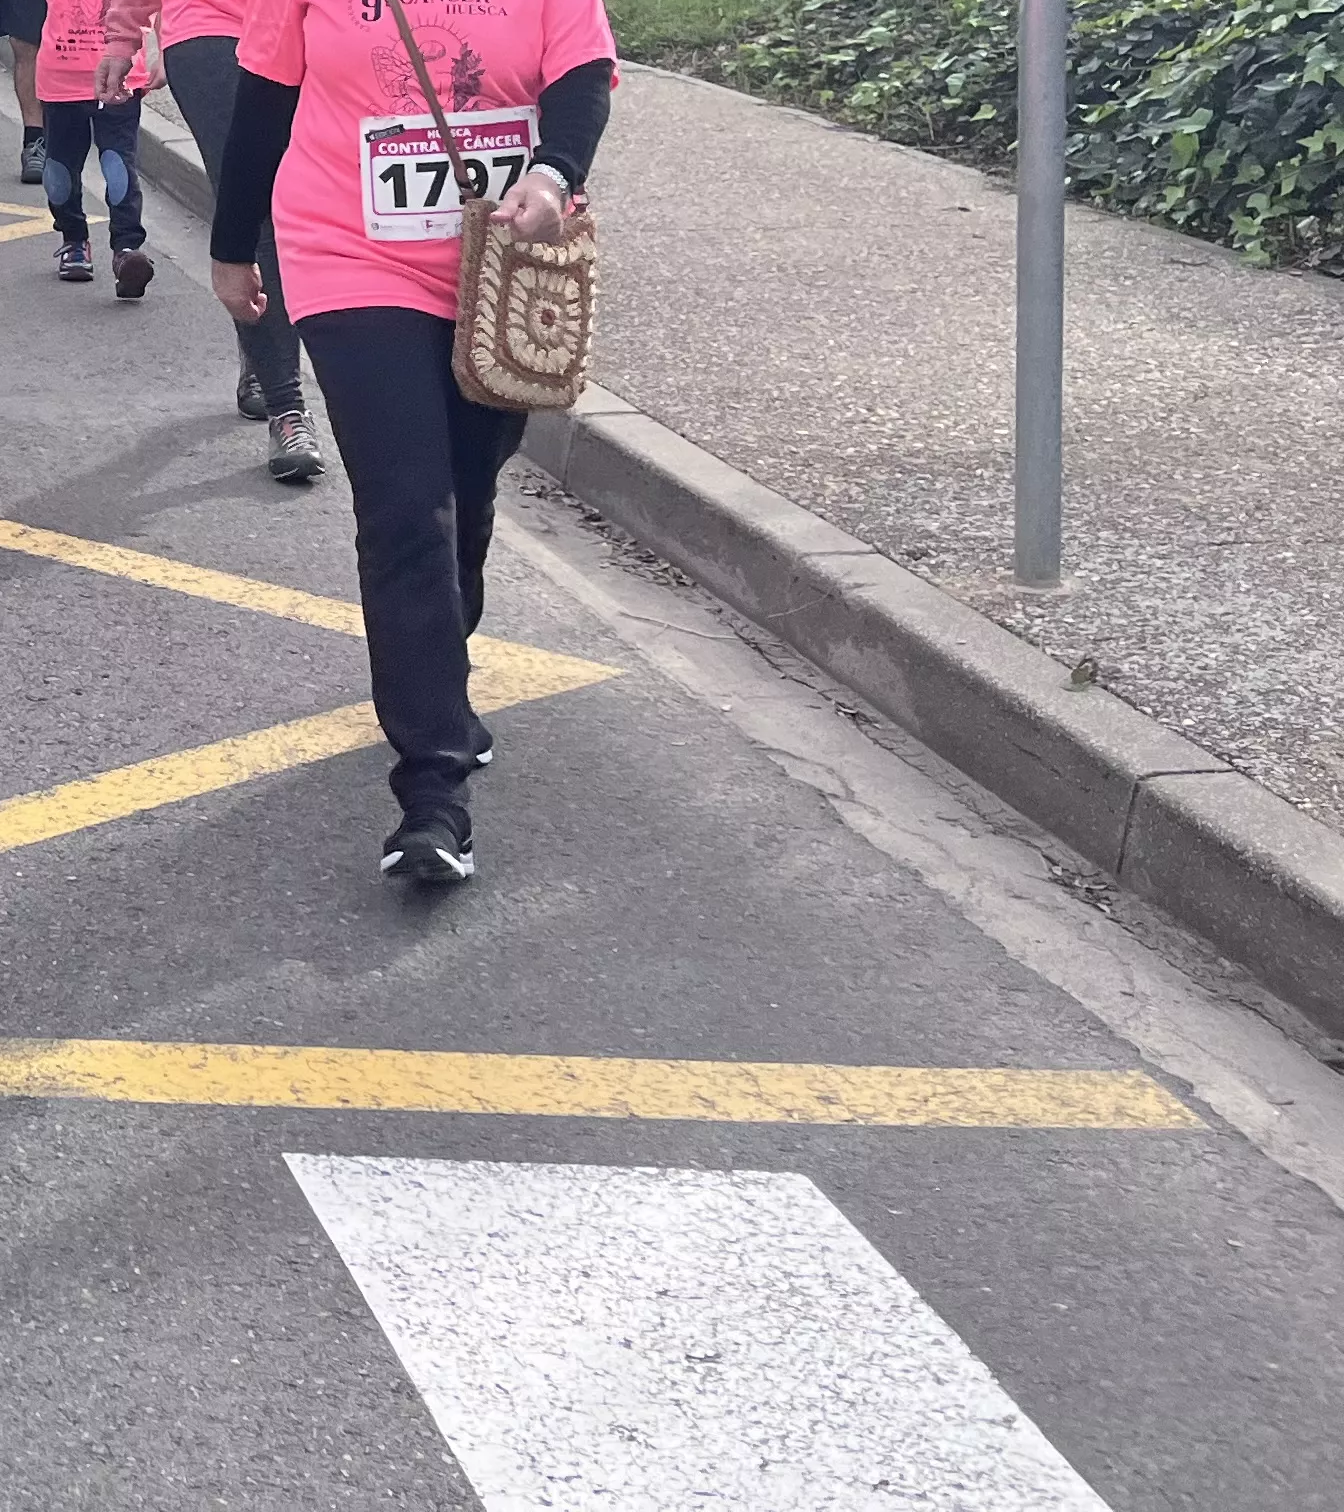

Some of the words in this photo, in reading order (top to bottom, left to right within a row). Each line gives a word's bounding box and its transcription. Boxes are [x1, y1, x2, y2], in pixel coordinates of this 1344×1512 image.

[445, 3, 508, 17] HUESCA
[427, 127, 472, 140] HUSCA
[378, 140, 441, 156] CONTRA
[463, 133, 522, 151] CÁNCER
[378, 153, 526, 209] 1797
